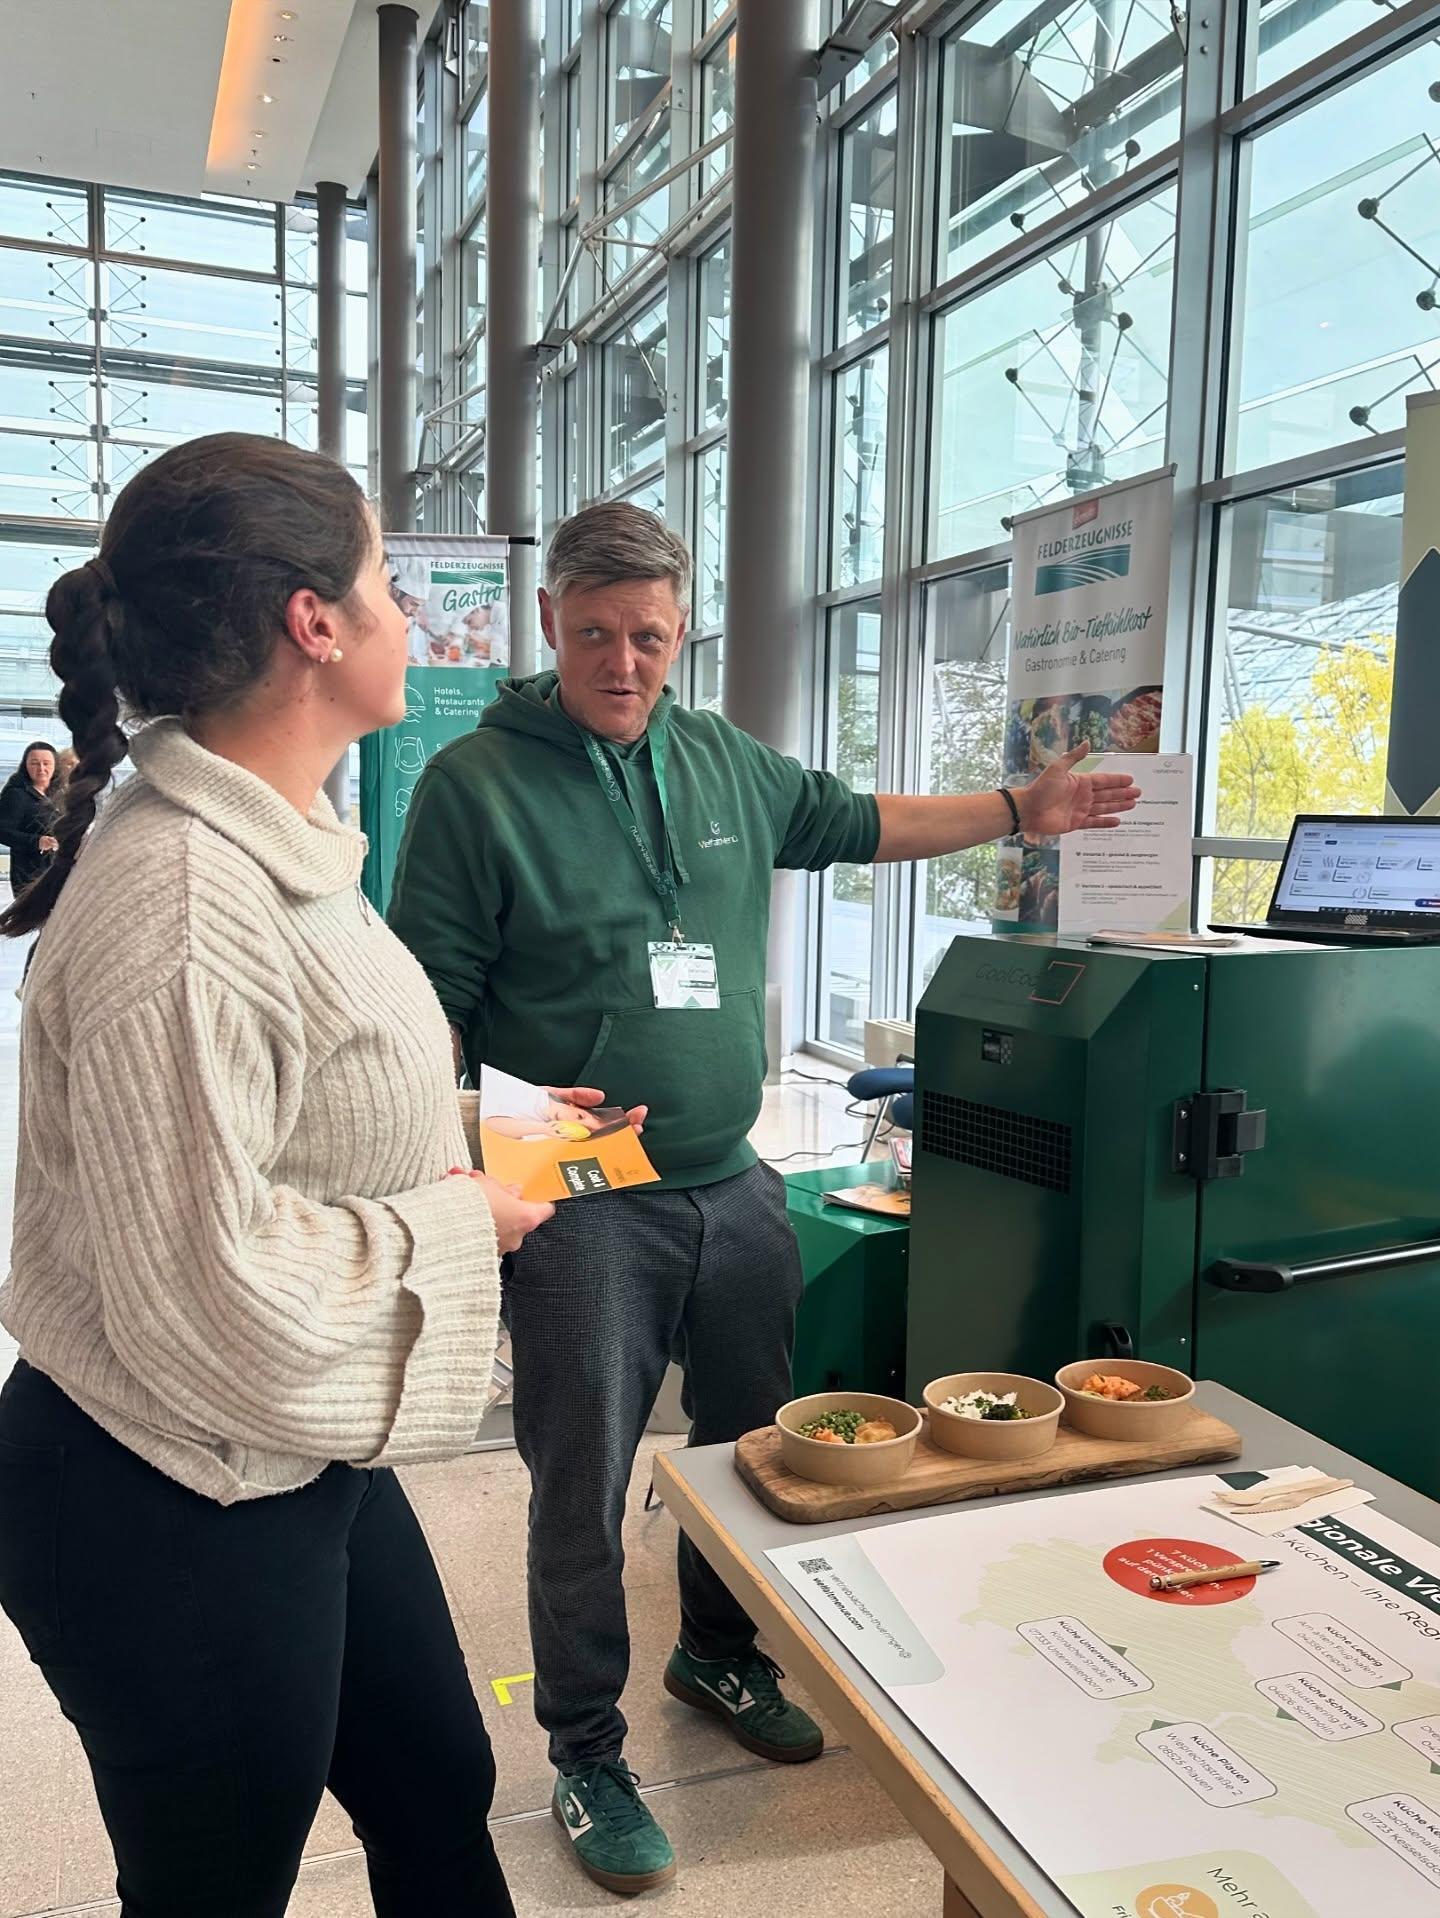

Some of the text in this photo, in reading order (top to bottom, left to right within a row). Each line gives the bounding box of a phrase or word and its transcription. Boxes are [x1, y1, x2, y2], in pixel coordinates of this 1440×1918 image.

[1037, 519, 1134, 560] FELDERZEUGNISSE
[430, 561, 505, 570] FELDERZEUGNISSE
[442, 584, 505, 612] Gastro
[1014, 606, 1153, 651] Natürlich Bio-Tiefkühlkost
[1025, 647, 1127, 672] Gastronomie & Catering
[434, 687, 464, 697] Hotels,
[434, 697, 485, 706] Restaurants
[434, 707, 479, 718] & Catering
[1302, 1519, 1403, 1576] gionale
[1117, 1556, 1139, 1567] auf
[1360, 1588, 1400, 1610] Ihre
[1058, 1620, 1081, 1639] Küche
[1298, 1620, 1314, 1632] Am
[1325, 1626, 1383, 1667] Küche Leipzig
[1321, 1650, 1352, 1673] Leipzig
[1298, 1677, 1327, 1699] Küche
[1190, 1735, 1250, 1784] Küche Plauen
[1183, 1764, 1213, 1792] Plauen
[1362, 1811, 1394, 1834] 01723
[1393, 1800, 1427, 1825] Küche
[1206, 1868, 1258, 1907] Mehr
